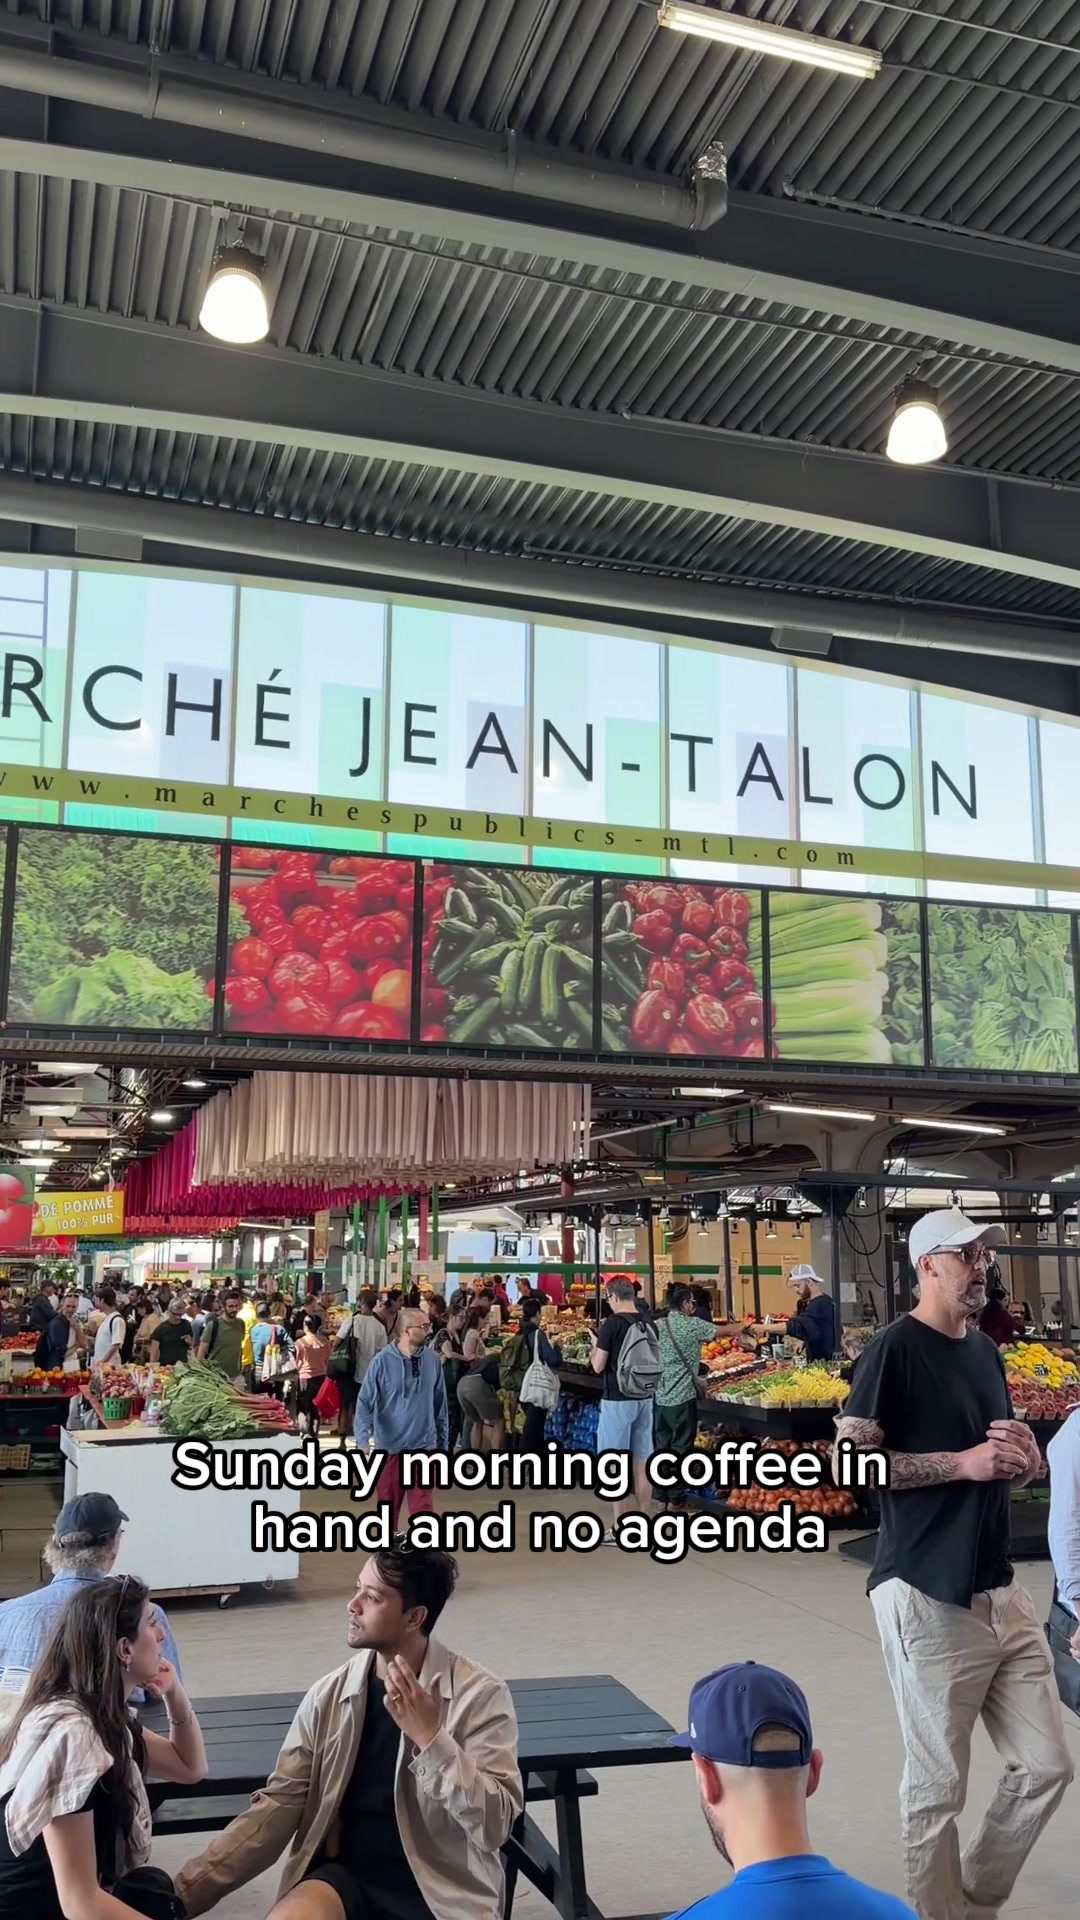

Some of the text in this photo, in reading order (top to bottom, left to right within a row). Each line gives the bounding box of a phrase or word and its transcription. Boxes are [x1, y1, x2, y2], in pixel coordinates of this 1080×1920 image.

[349, 697, 978, 819] JEAN-TALON
[40, 1195, 114, 1218] DE POMME
[57, 1213, 114, 1231] 100% PUR
